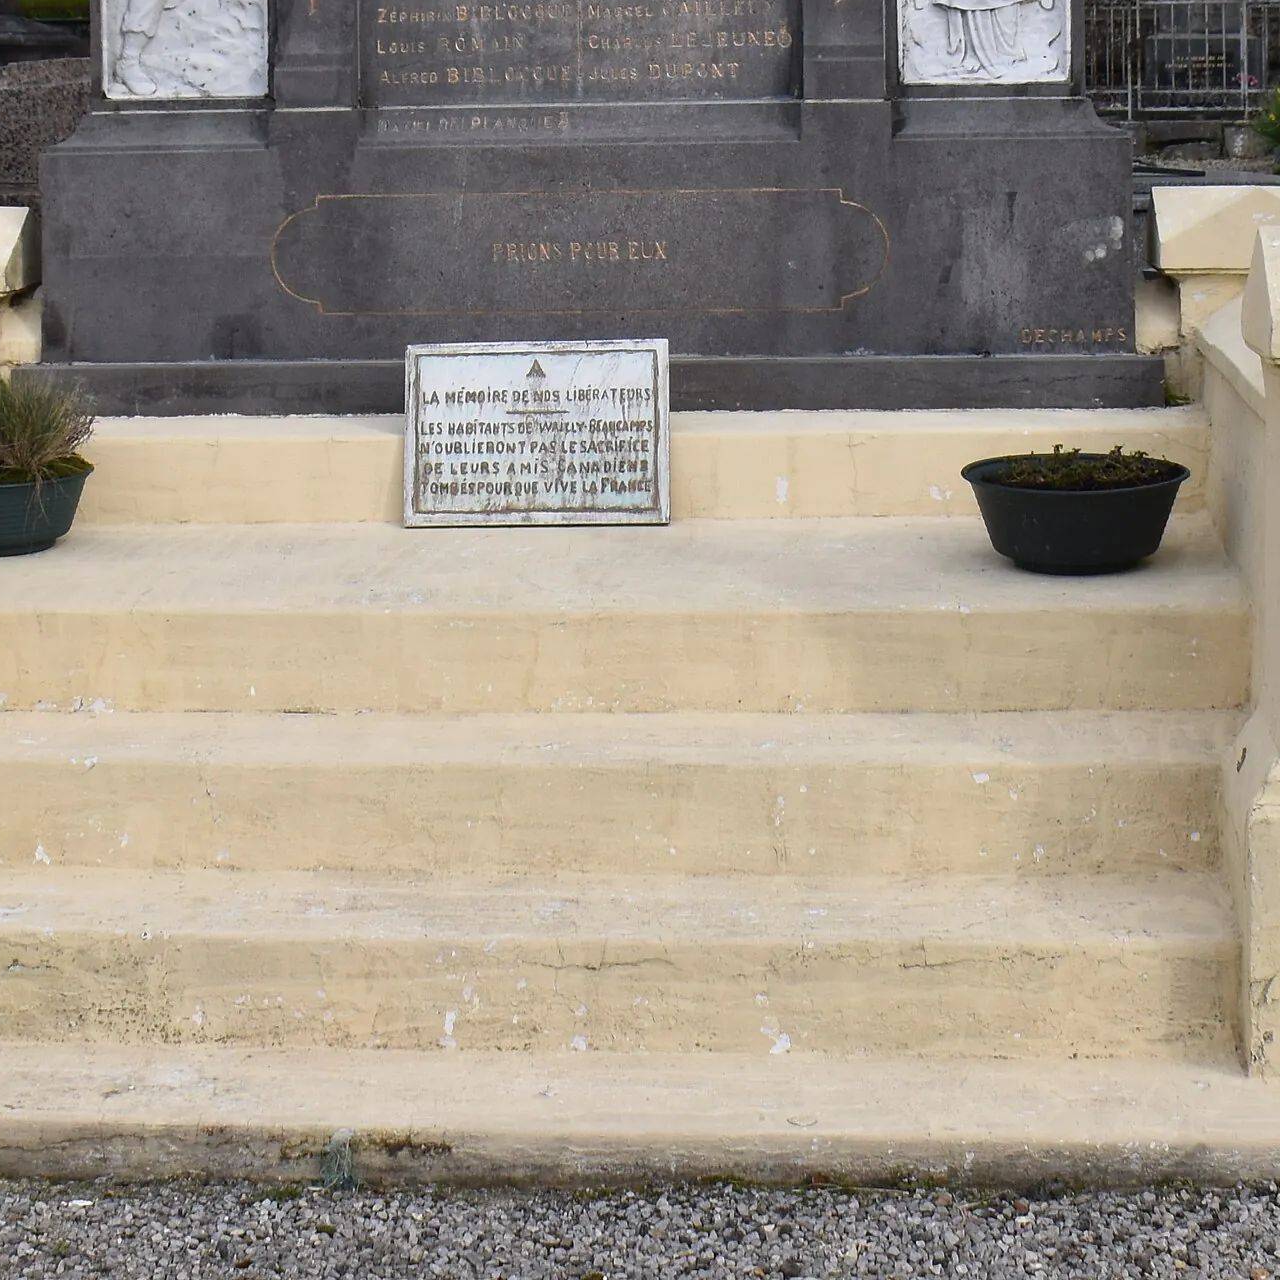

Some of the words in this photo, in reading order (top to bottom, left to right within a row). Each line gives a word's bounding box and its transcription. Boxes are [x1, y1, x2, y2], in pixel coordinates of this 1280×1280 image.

[377, 6, 455, 24] ZÉPHIRIN
[587, 4, 653, 20] MARCEL
[670, 28, 776, 48] LEJEUNE
[376, 39, 427, 56] LOUIS
[379, 69, 440, 86] ALFRED
[588, 66, 638, 81] JULES
[647, 61, 740, 80] DUPONT
[491, 241, 562, 263] PRIONS
[568, 240, 620, 262] POUR
[626, 239, 669, 261] EUX
[1020, 327, 1127, 344] DECHAMPS
[422, 390, 440, 405] LA
[445, 386, 508, 405] MÉMOIRE
[512, 389, 529, 403] DE
[533, 389, 560, 404] NOS
[566, 385, 651, 403] LIBÉRATEURS
[421, 420, 442, 435] LES
[448, 418, 515, 435] HABITANTS
[517, 420, 533, 434] DE
[530, 440, 557, 454] PAS
[561, 439, 576, 454] LE
[579, 436, 649, 454] SACRIFICE
[424, 461, 444, 475] DE
[450, 461, 500, 475] LEURS
[506, 458, 549, 475] AMIS
[557, 457, 649, 474] CANADIENS
[476, 480, 512, 494] POUR
[514, 480, 539, 496] QUE
[543, 479, 577, 494] VIVE
[581, 479, 597, 494] LA
[601, 476, 652, 493] FRANCE
